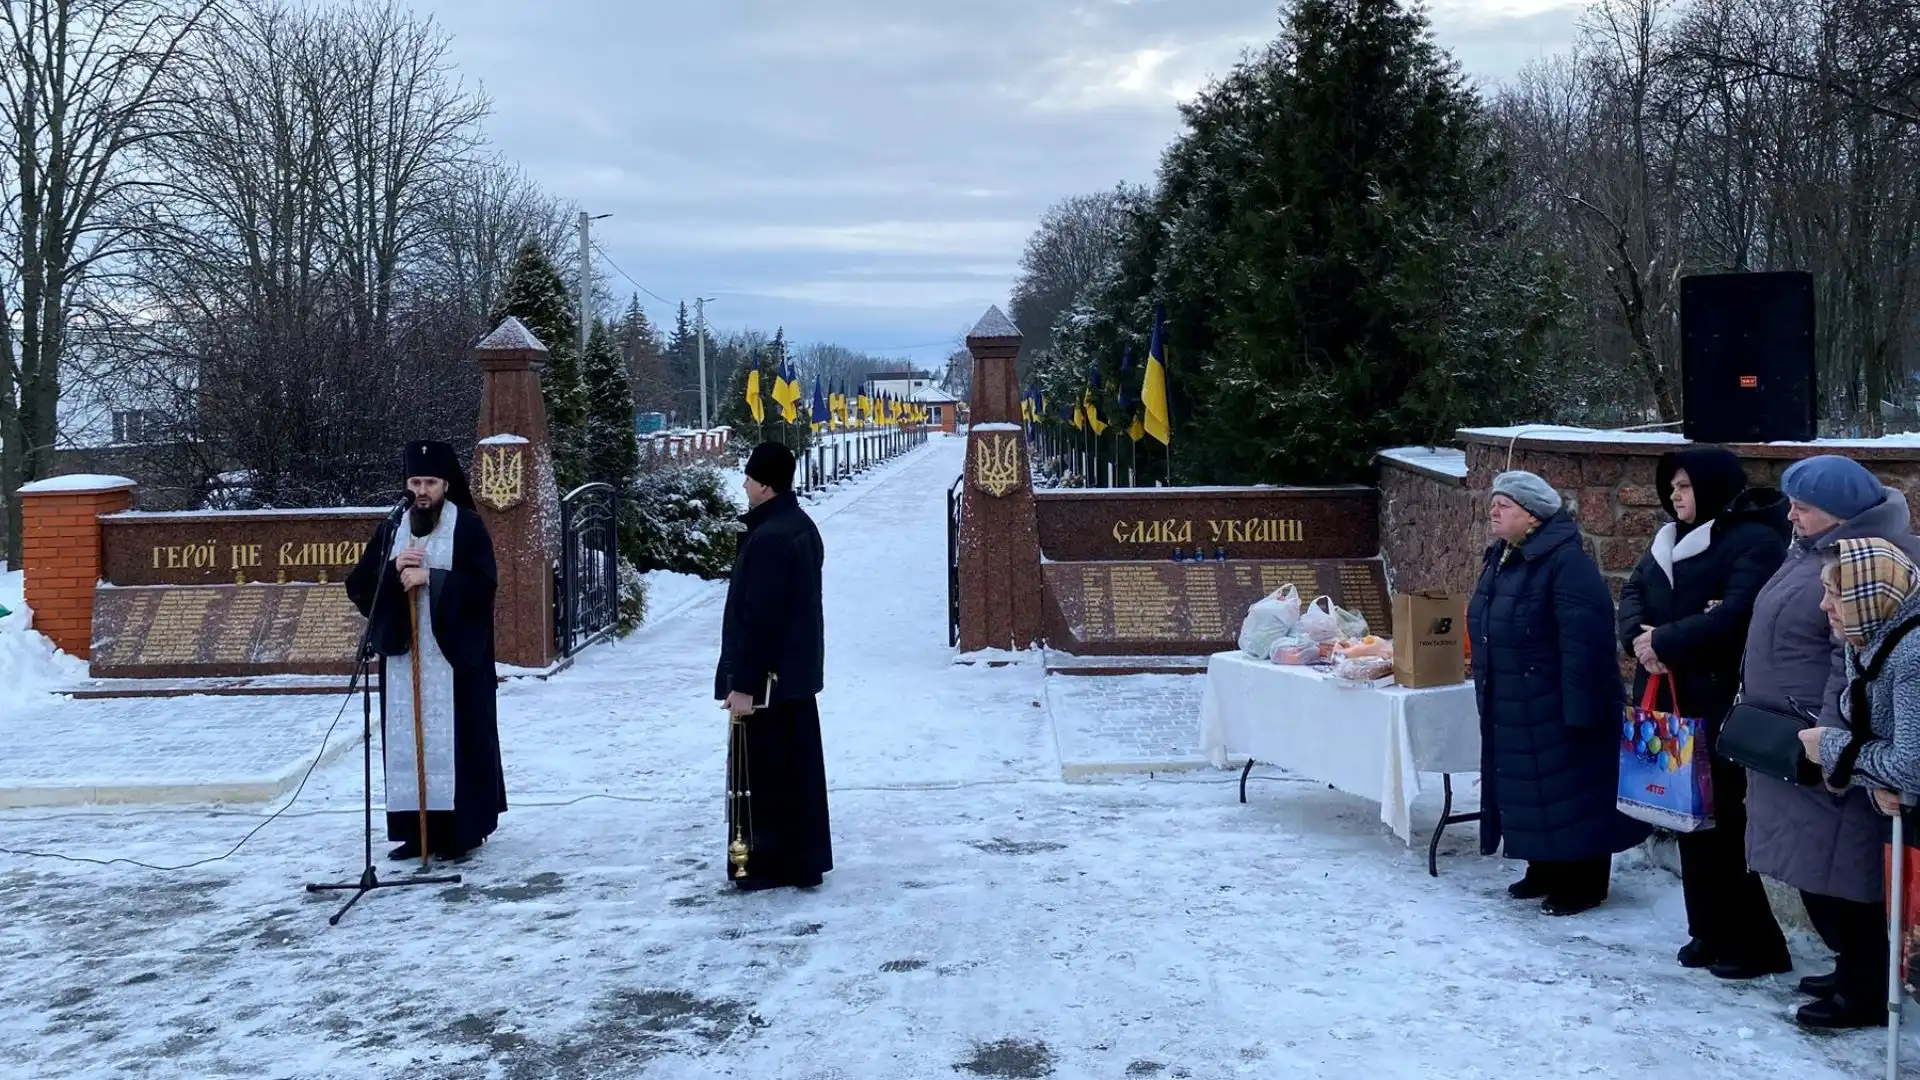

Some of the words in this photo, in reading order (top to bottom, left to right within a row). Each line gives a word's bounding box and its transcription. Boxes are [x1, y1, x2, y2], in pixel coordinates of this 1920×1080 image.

[1112, 518, 1192, 543] СЛАВА
[1207, 516, 1304, 542] УКРАЇНІ
[152, 539, 217, 569] ГЕРОЇ
[231, 543, 262, 568] НЕ
